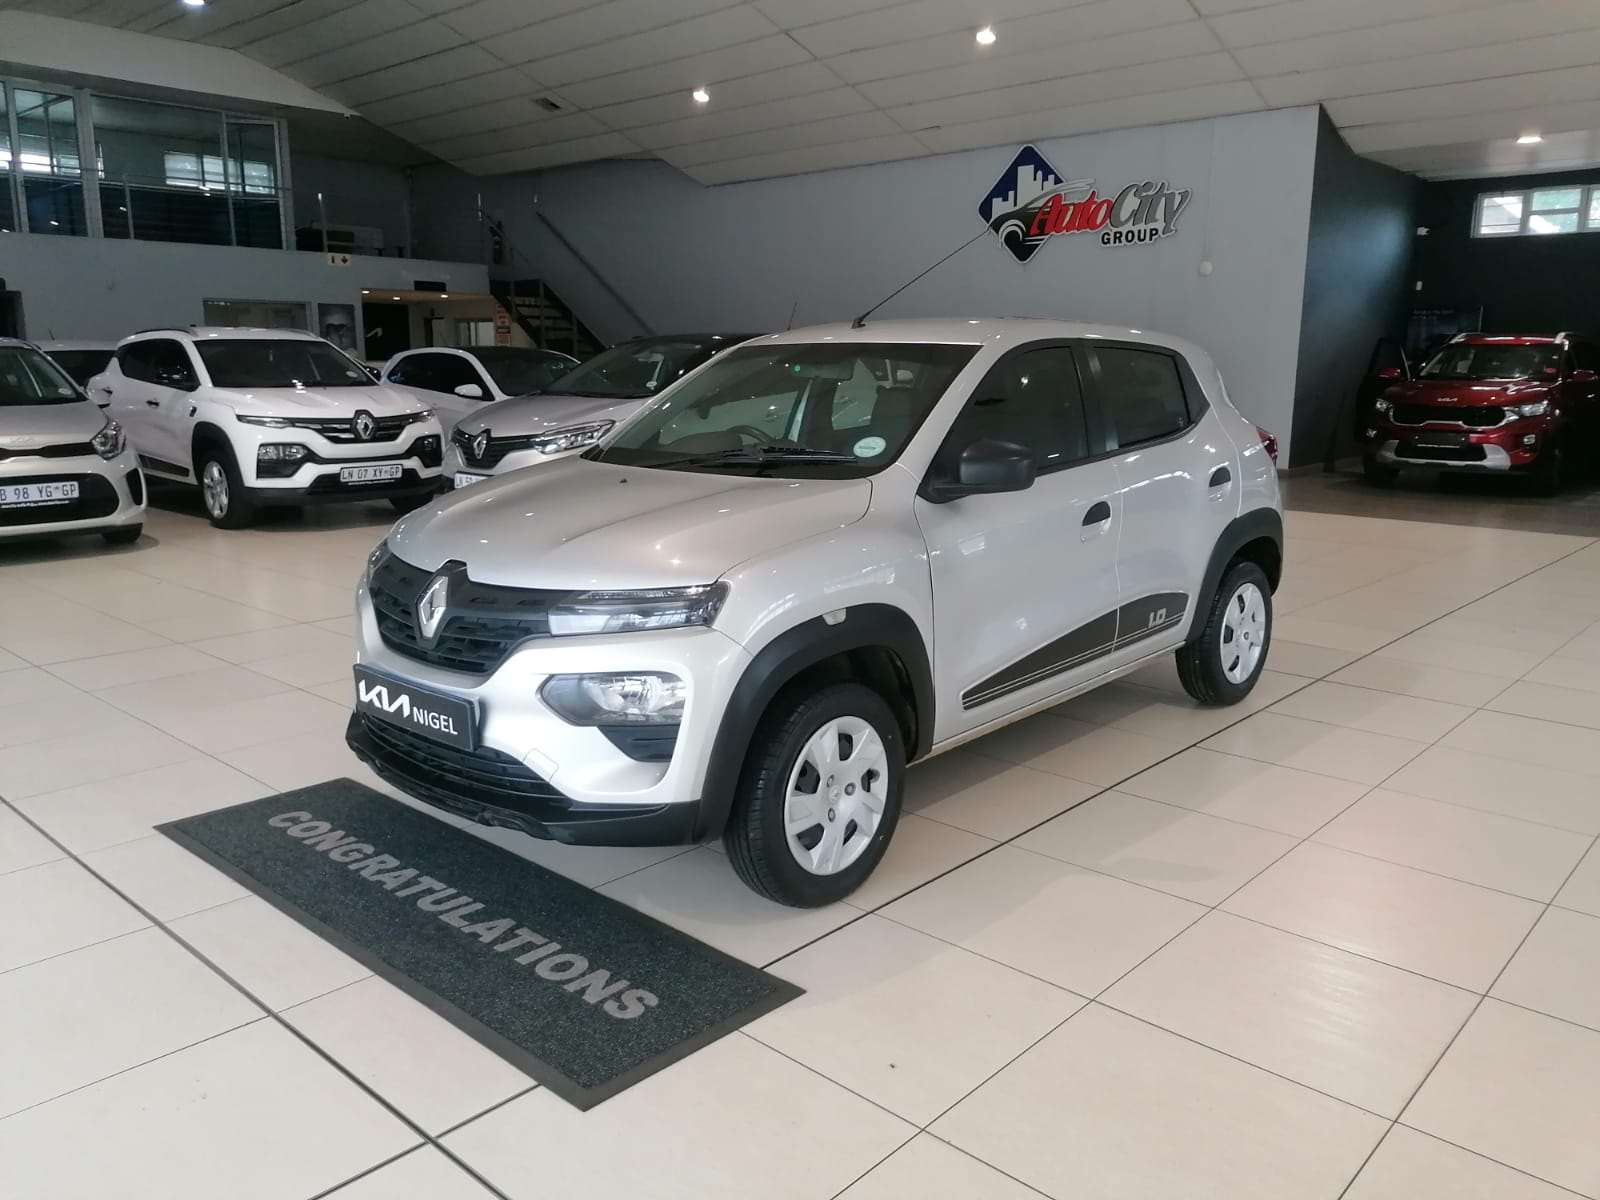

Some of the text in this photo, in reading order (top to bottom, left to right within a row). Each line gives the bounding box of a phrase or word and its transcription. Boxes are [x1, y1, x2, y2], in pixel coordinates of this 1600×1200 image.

[1101, 227, 1159, 245] GROUP
[372, 467, 384, 478] XY
[14, 487, 29, 500] 98
[37, 485, 52, 498] YG
[62, 483, 77, 496] GP
[412, 706, 458, 735] NIGEL
[268, 811, 659, 1020] CONGRATULATIONS
